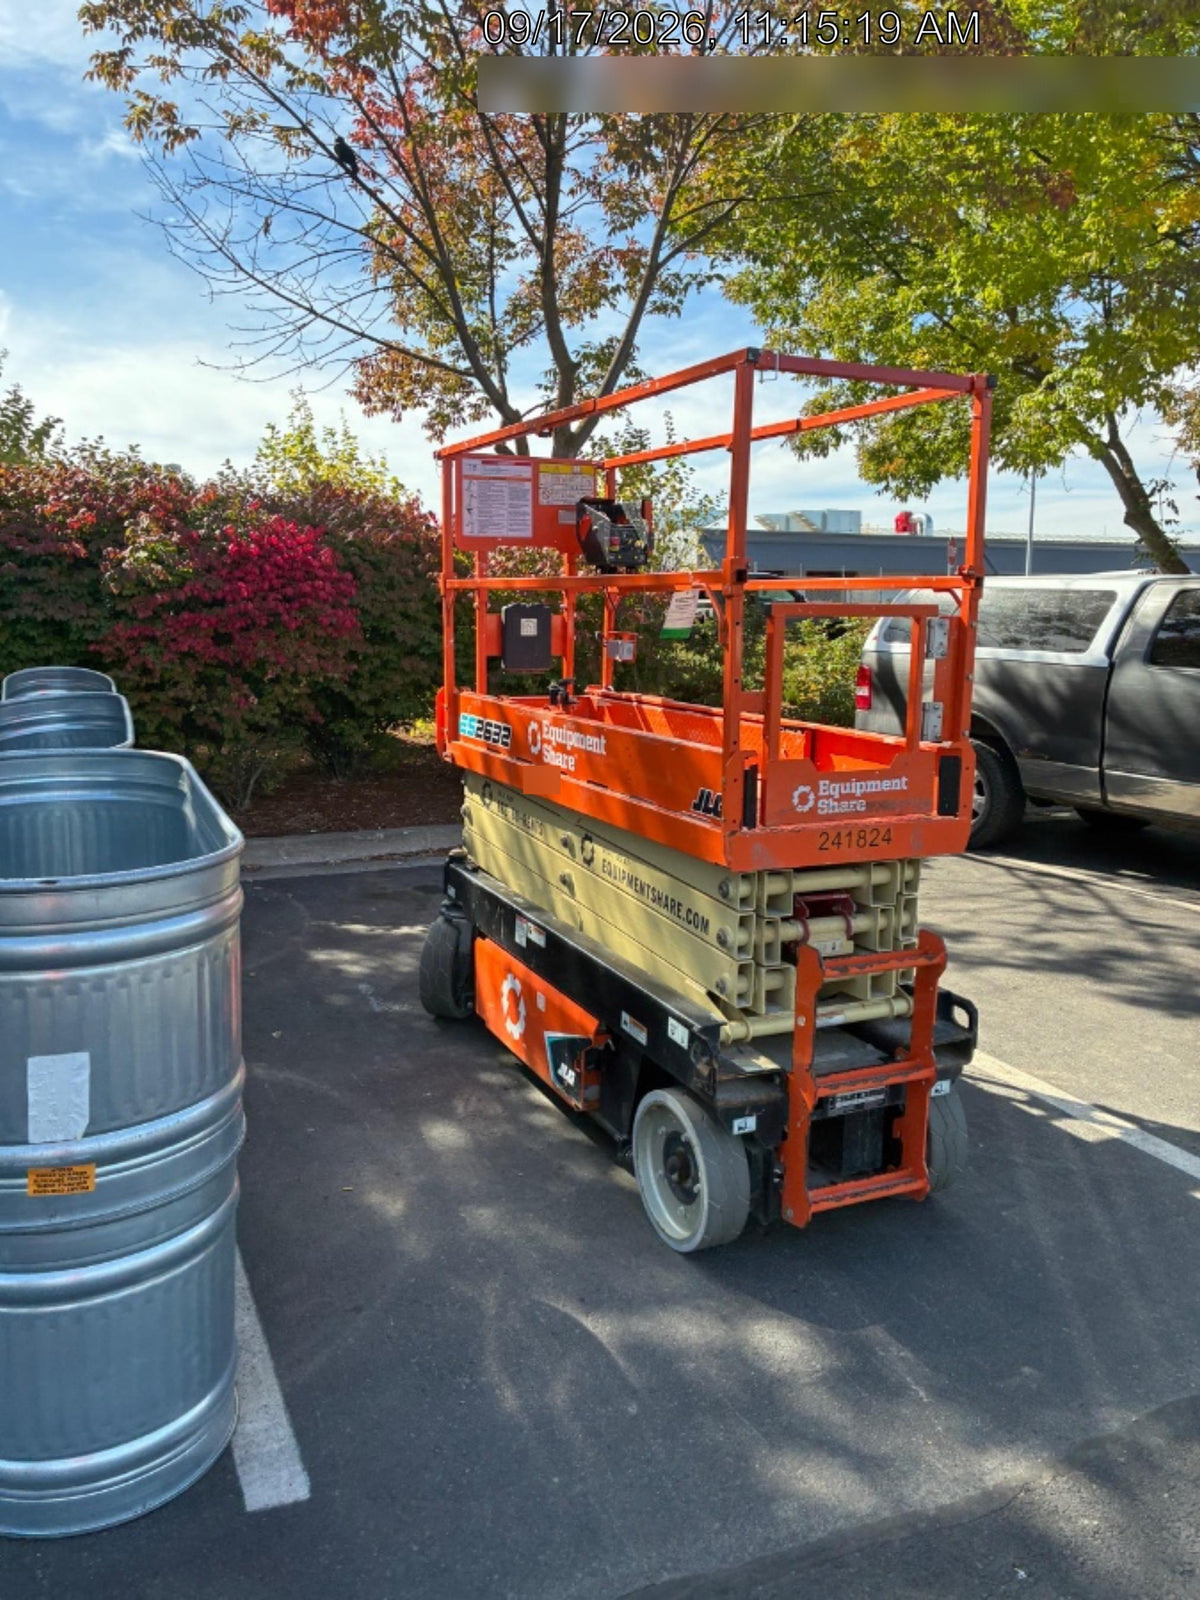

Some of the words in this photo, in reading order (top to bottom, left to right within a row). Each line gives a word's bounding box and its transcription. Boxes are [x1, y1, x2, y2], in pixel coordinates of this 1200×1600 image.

[541, 719, 607, 755] Equipment
[541, 744, 576, 771] Share
[818, 776, 909, 799] Equipment
[817, 799, 867, 815] Share
[818, 827, 893, 851] 241824
[601, 858, 710, 936] EQUIPMENTSHARE.COM
